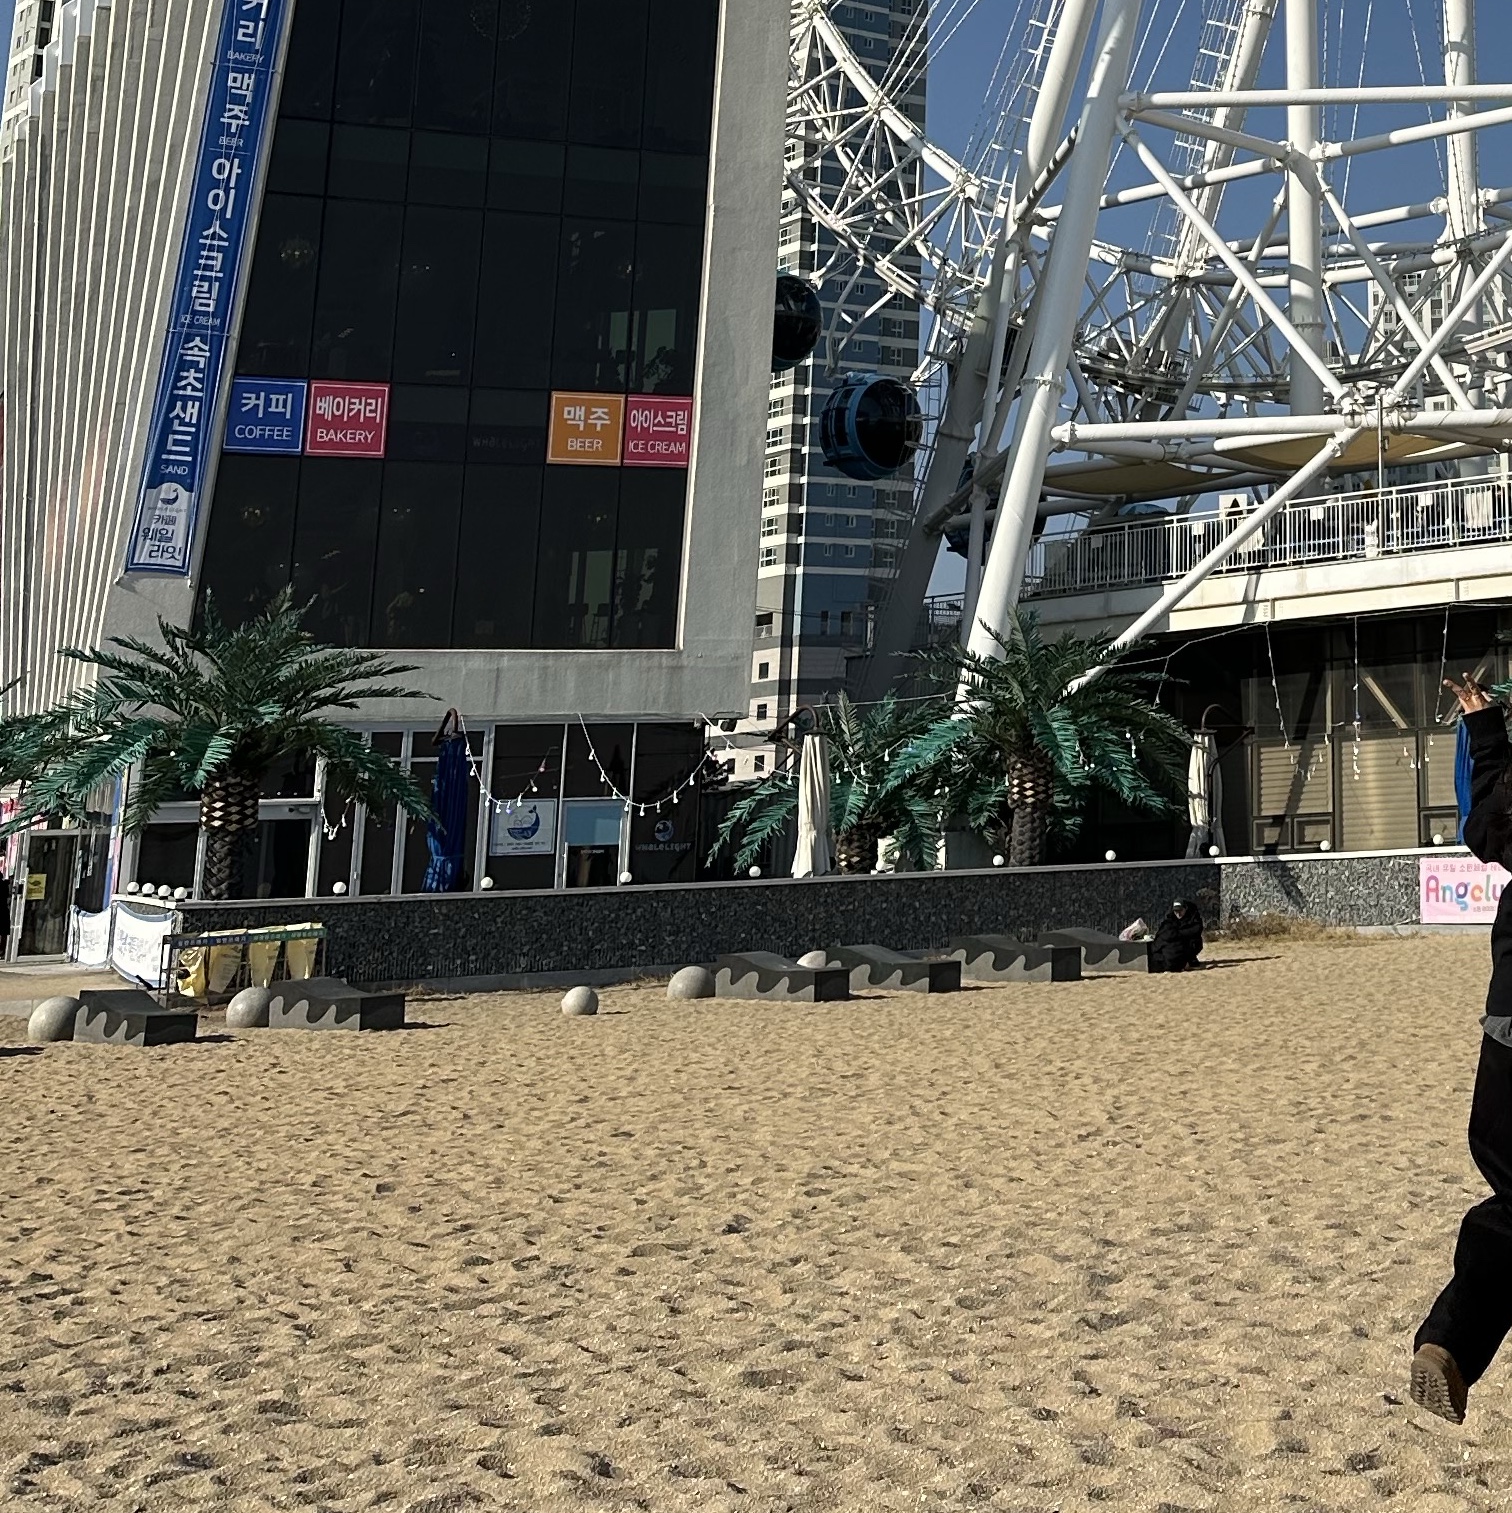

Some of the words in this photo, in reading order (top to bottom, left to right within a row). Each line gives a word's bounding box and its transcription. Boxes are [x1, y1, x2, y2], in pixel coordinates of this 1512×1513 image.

[227, 50, 265, 64] BAKERY
[220, 71, 255, 133] 맥주
[191, 158, 242, 312] 아이스크림
[240, 391, 293, 419] 커피
[316, 395, 382, 423] 베이커리
[563, 405, 611, 432] 맥주
[630, 408, 688, 435] 아이스크림
[234, 425, 293, 440] COFFEE
[316, 428, 376, 444] BAKERY
[567, 438, 603, 451] BEER
[628, 440, 645, 452] ICE
[647, 440, 686, 454] CREAM
[159, 464, 189, 475] SAND
[153, 514, 177, 526] 카페
[141, 527, 175, 543] 웨일
